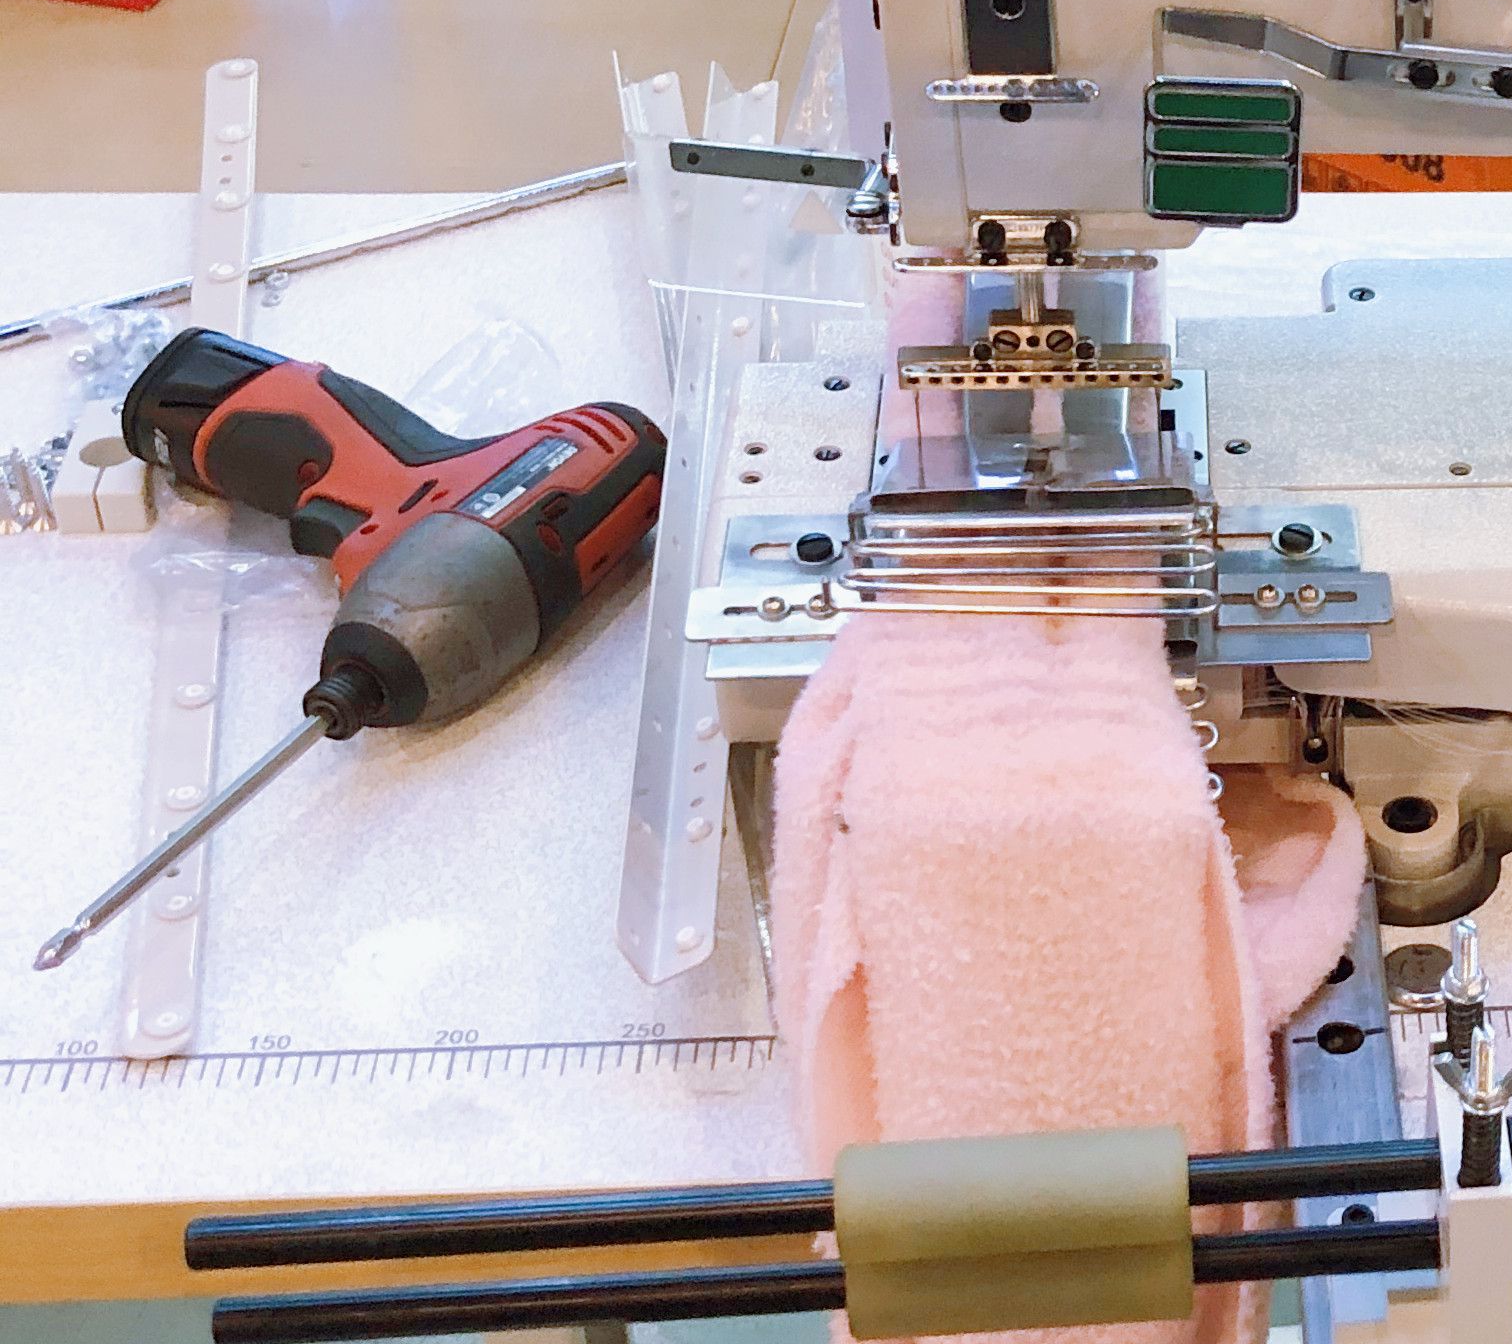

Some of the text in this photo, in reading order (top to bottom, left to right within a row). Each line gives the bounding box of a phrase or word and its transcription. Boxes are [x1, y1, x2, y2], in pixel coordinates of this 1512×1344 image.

[55, 1022, 666, 1056] 100 150 200 250
